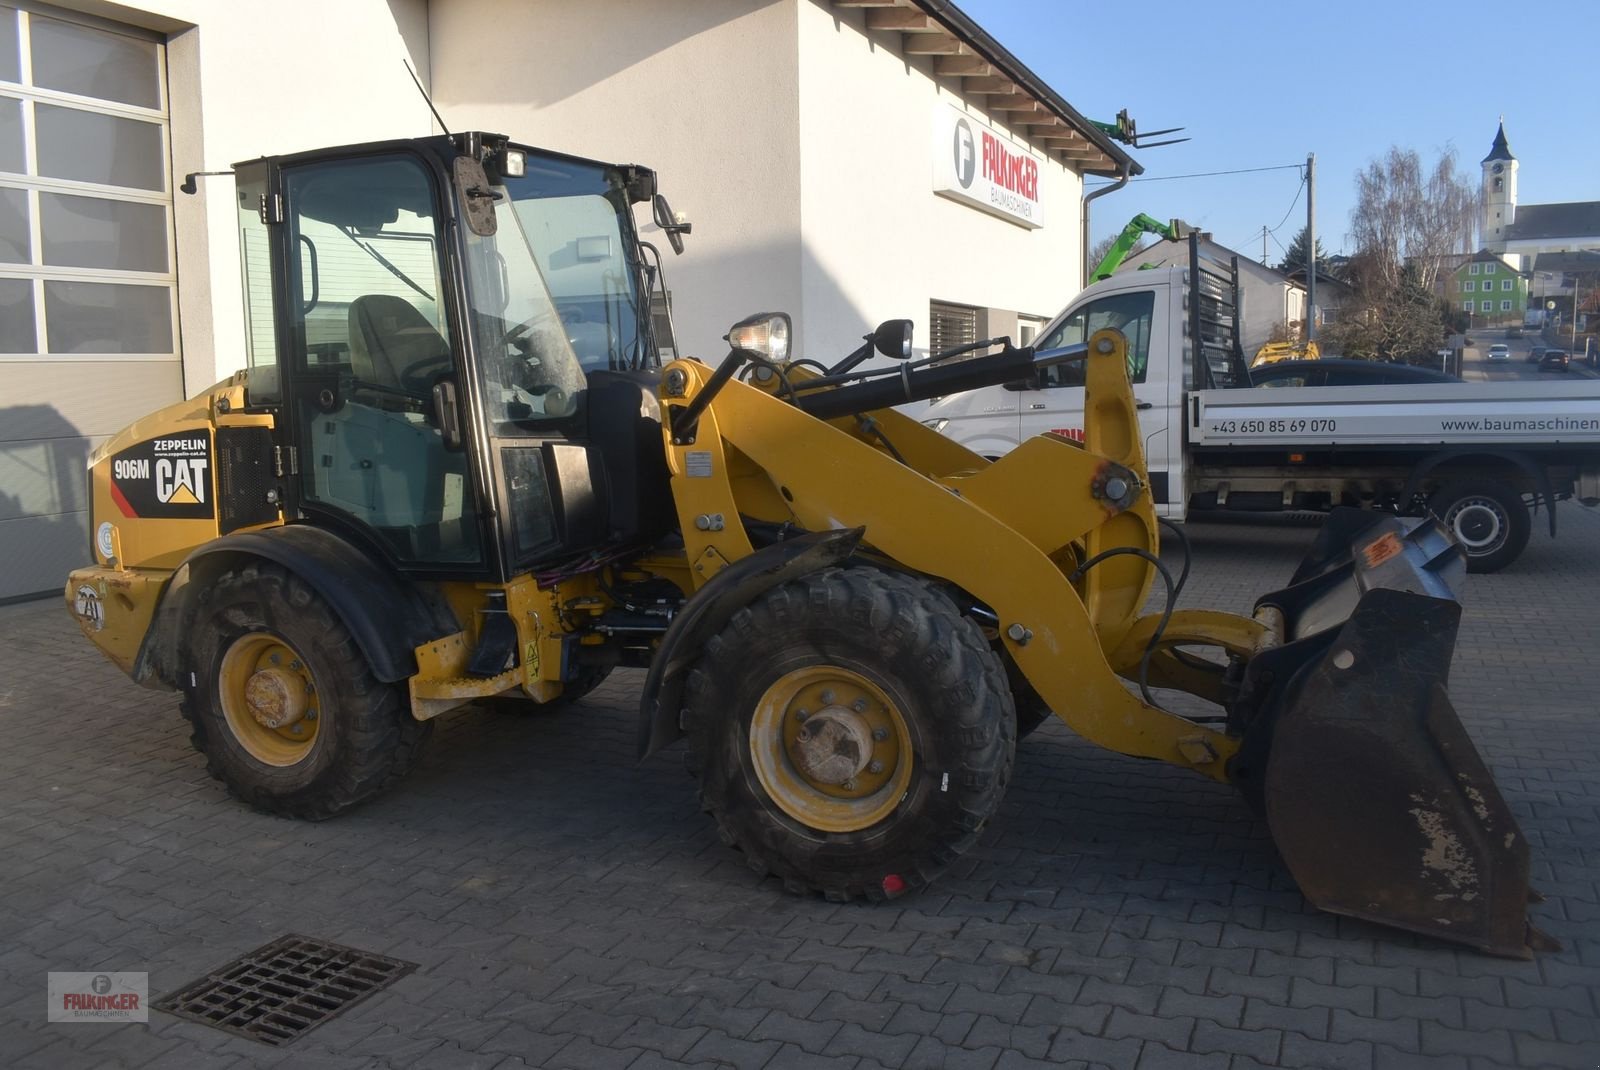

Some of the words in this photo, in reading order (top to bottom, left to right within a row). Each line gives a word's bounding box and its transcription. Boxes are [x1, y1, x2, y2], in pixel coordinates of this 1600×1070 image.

[982, 130, 1038, 203] FALKINGER
[1212, 421, 1236, 433] +43
[1240, 420, 1265, 433] 650
[1269, 420, 1285, 432] 85
[1290, 420, 1306, 432] 69
[1310, 419, 1336, 432] 070
[1441, 417, 1599, 431] www.baumaschinen
[154, 439, 206, 451] ZEPPELIN
[115, 459, 149, 479] 906M
[156, 458, 207, 503] CAT
